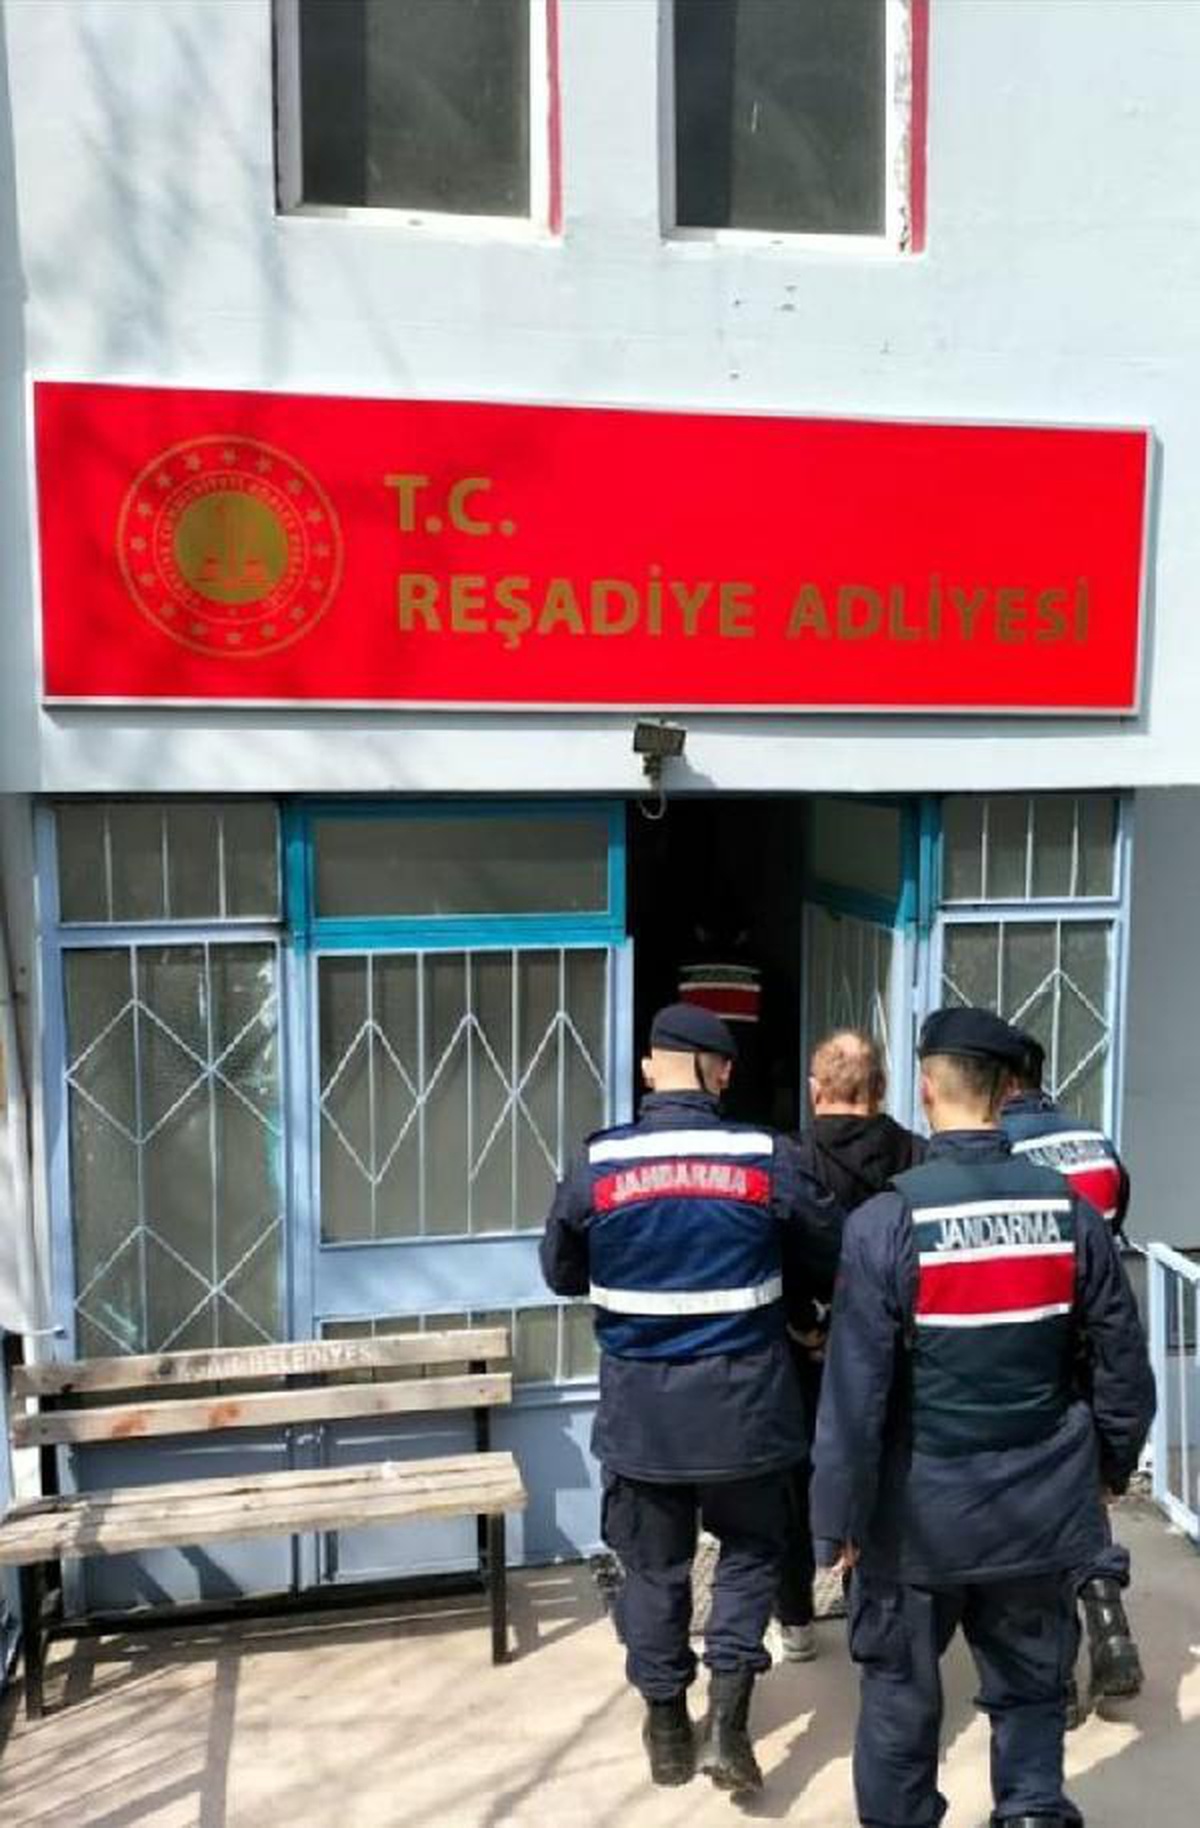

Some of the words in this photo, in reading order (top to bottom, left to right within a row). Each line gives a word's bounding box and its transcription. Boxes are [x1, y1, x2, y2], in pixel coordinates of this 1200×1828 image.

[384, 474, 515, 536] T.C.
[398, 565, 755, 648] REŞADİYE
[785, 574, 1091, 645] ADLİYESİ
[612, 1163, 748, 1200] JANDARMA
[934, 1212, 1062, 1250] JANDARMA
